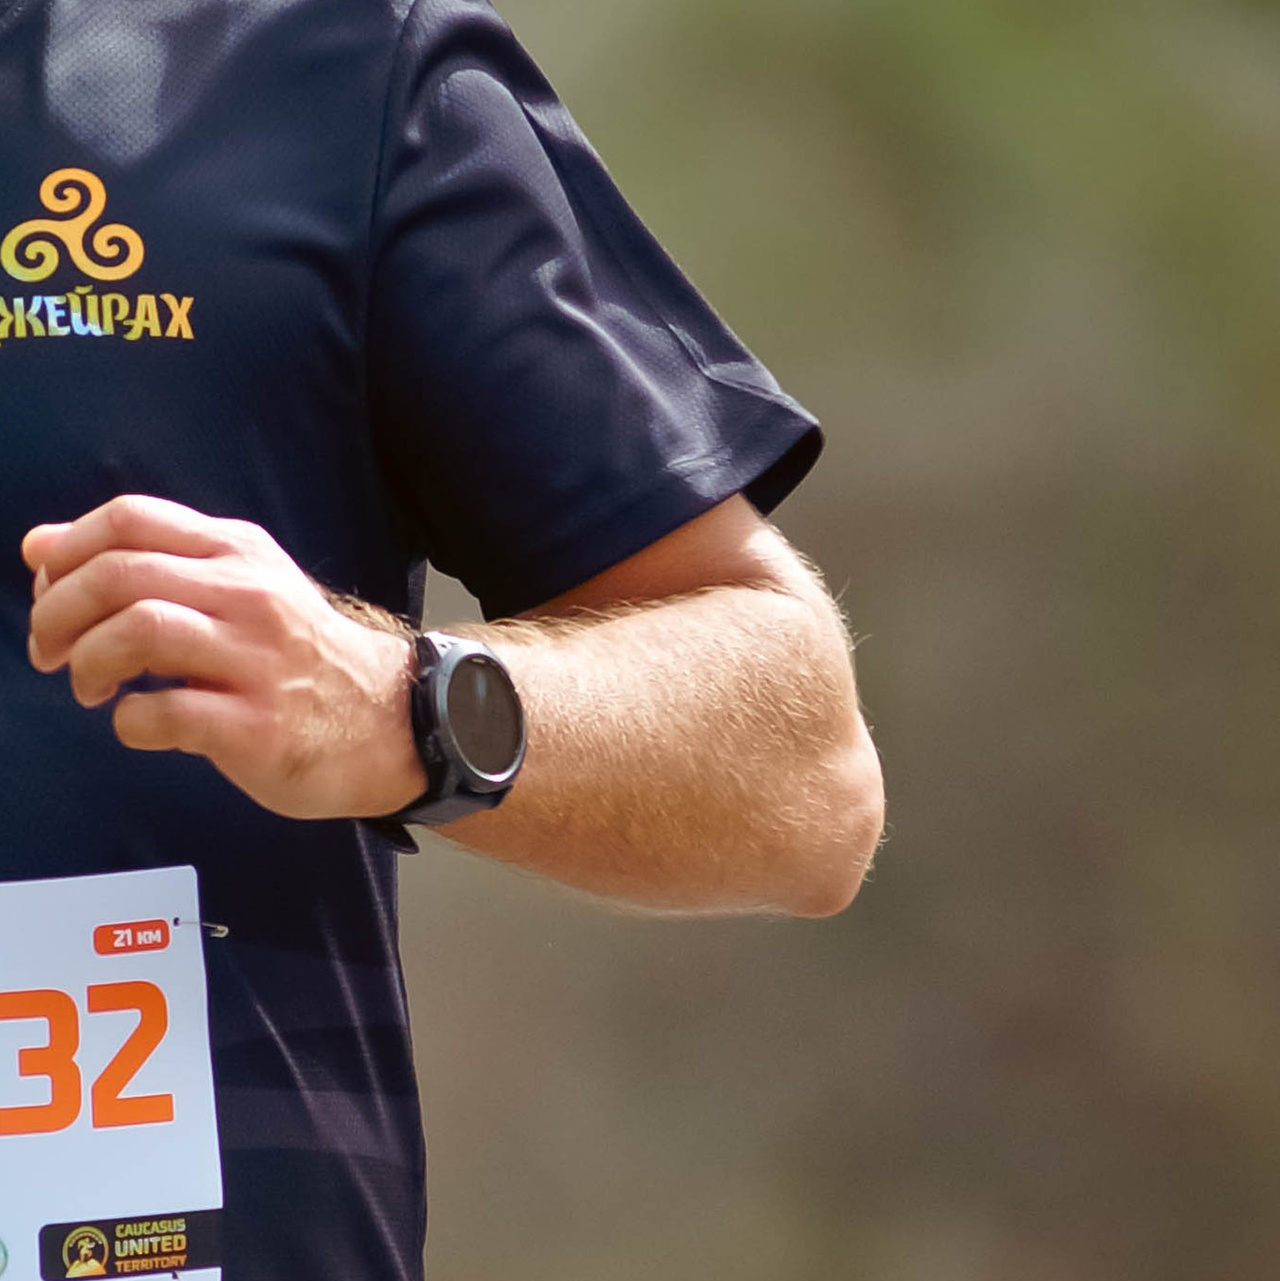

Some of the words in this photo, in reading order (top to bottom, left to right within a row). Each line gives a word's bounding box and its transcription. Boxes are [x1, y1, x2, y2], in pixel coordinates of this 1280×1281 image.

[112, 928, 133, 948] 21
[115, 1218, 186, 1238] CAUCASUS
[114, 1234, 187, 1257] UNITED
[115, 1254, 187, 1273] TERRITORY
